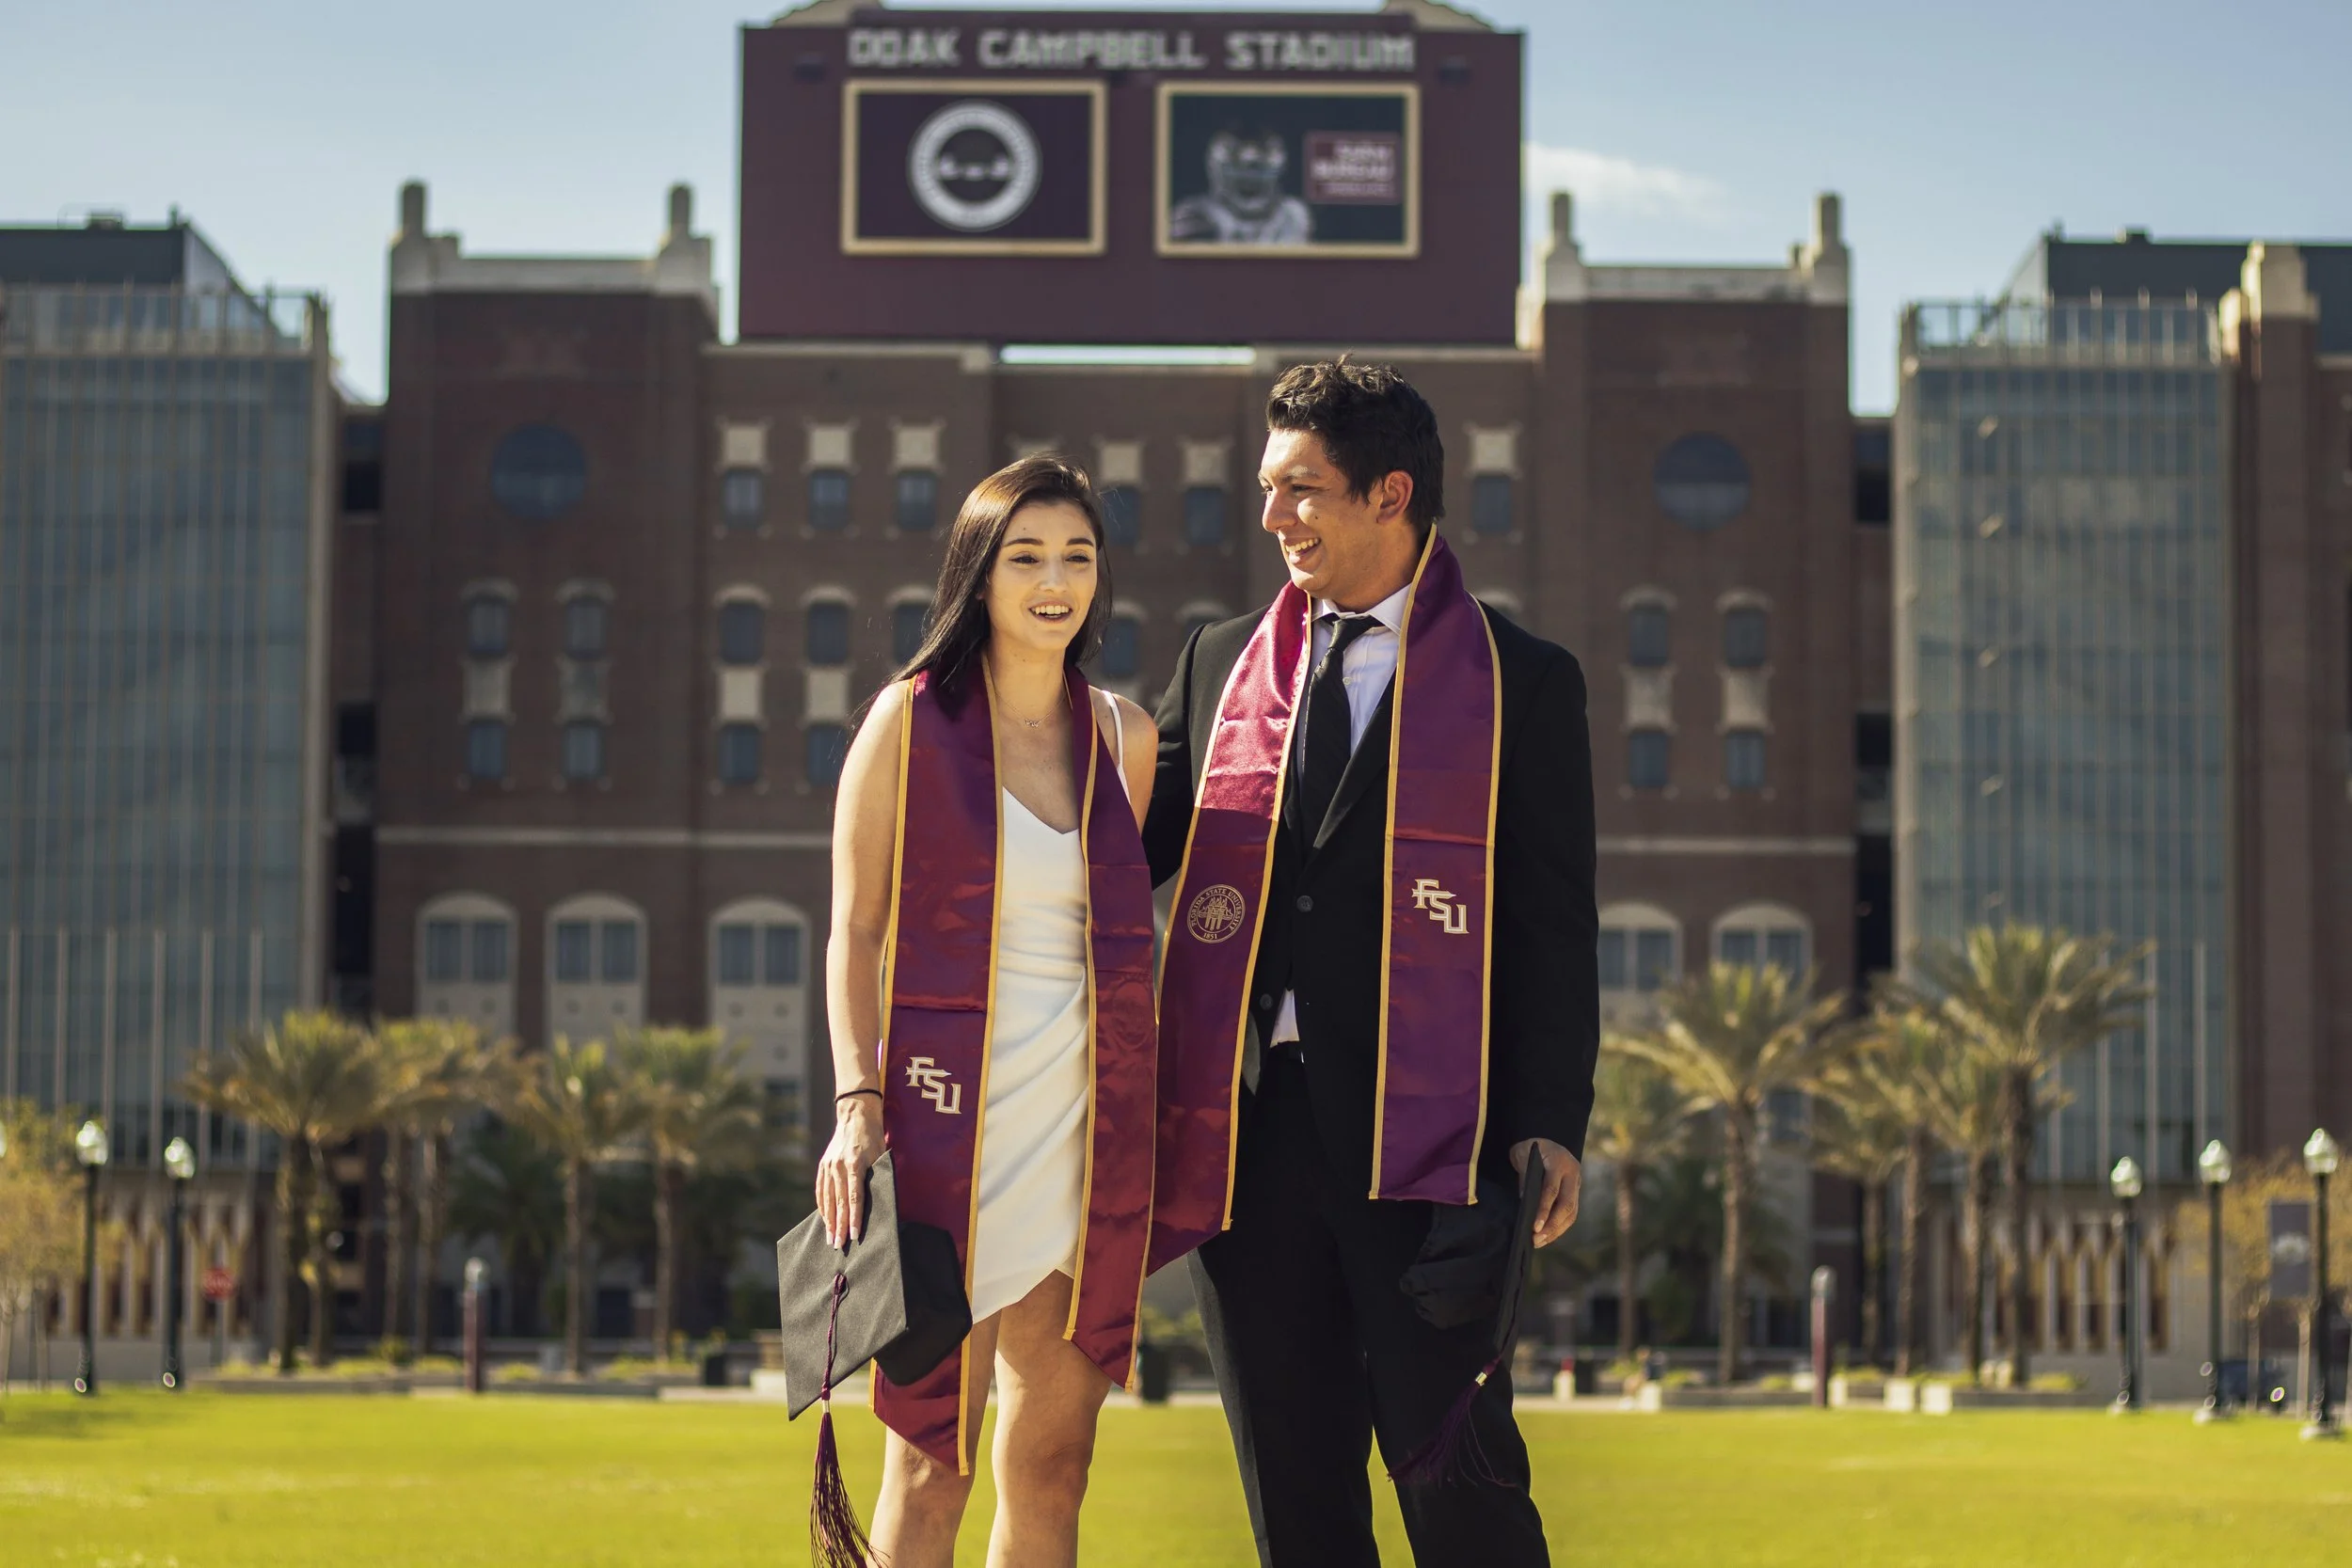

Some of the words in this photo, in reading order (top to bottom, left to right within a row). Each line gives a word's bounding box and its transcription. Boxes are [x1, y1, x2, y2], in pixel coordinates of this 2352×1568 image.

[849, 30, 959, 66] DOAK
[979, 30, 1206, 69] CAMPBELL
[1227, 31, 1414, 70] STADIUM
[1190, 895, 1205, 927] FLORIDA
[1205, 888, 1228, 896] STATE
[1228, 892, 1243, 931] UNIVERSITY
[1411, 879, 1470, 934] FSU
[905, 1056, 961, 1114] FSU
